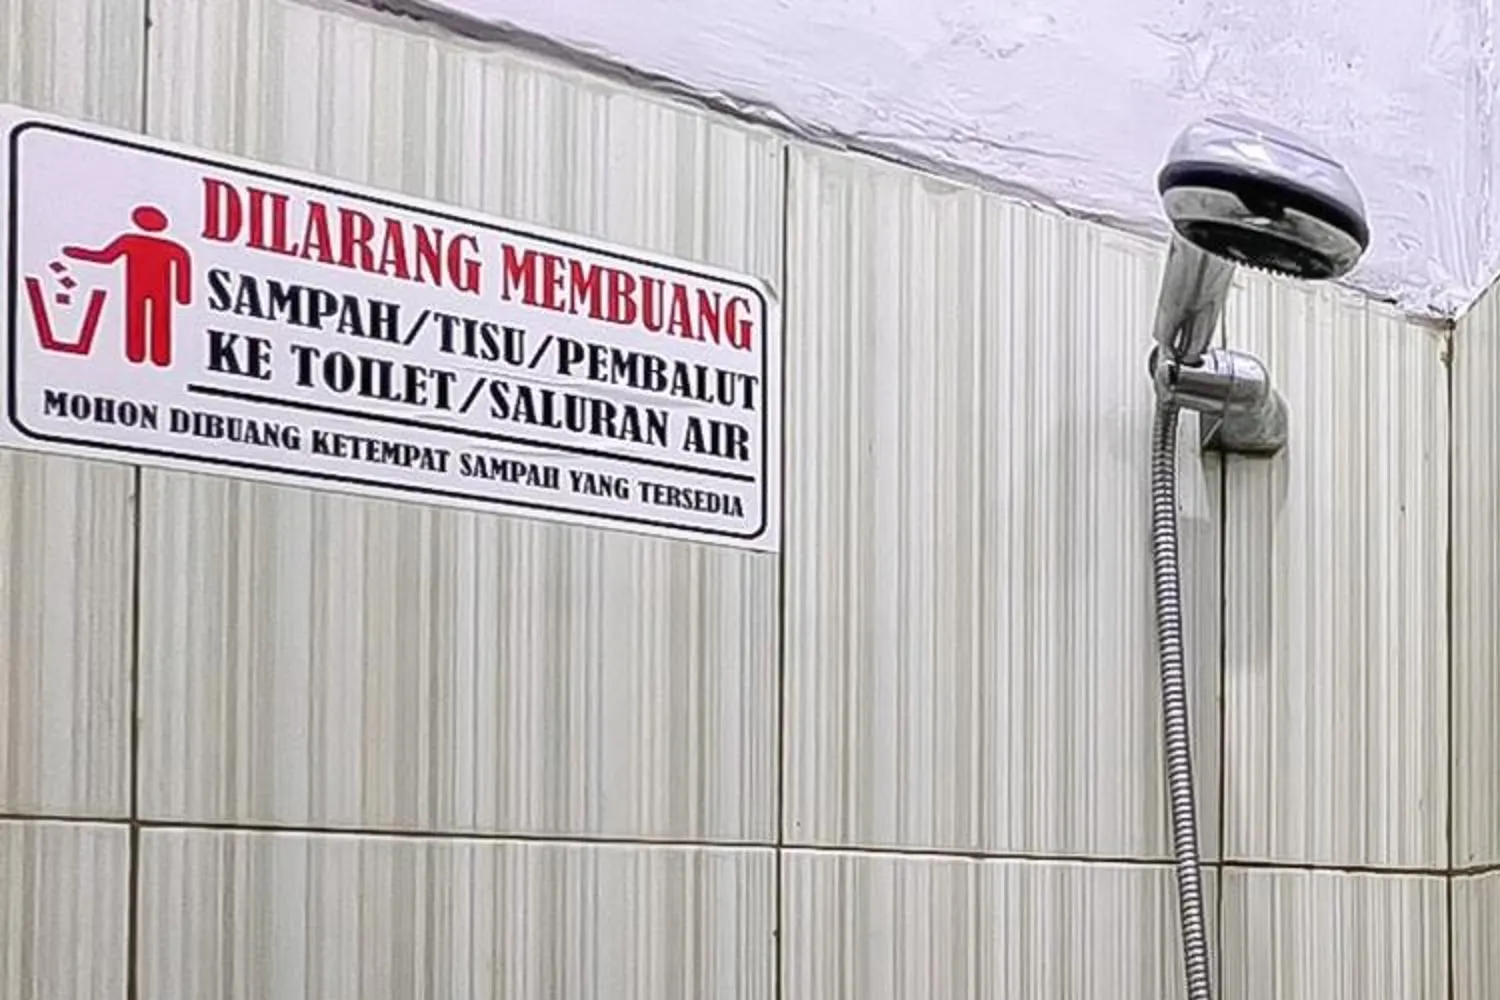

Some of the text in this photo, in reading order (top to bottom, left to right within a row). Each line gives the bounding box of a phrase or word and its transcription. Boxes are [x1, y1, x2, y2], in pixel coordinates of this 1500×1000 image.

[202, 177, 753, 351] DILARANG MEMBUANG
[208, 269, 758, 410] SAMPAH/TISU/PEMBALUT
[208, 329, 750, 461] KE TOILET/SALURAN AIR
[43, 389, 744, 518] MOHON DIBUANG KETEMPAT SAMPAH YANG TERSEDIA
